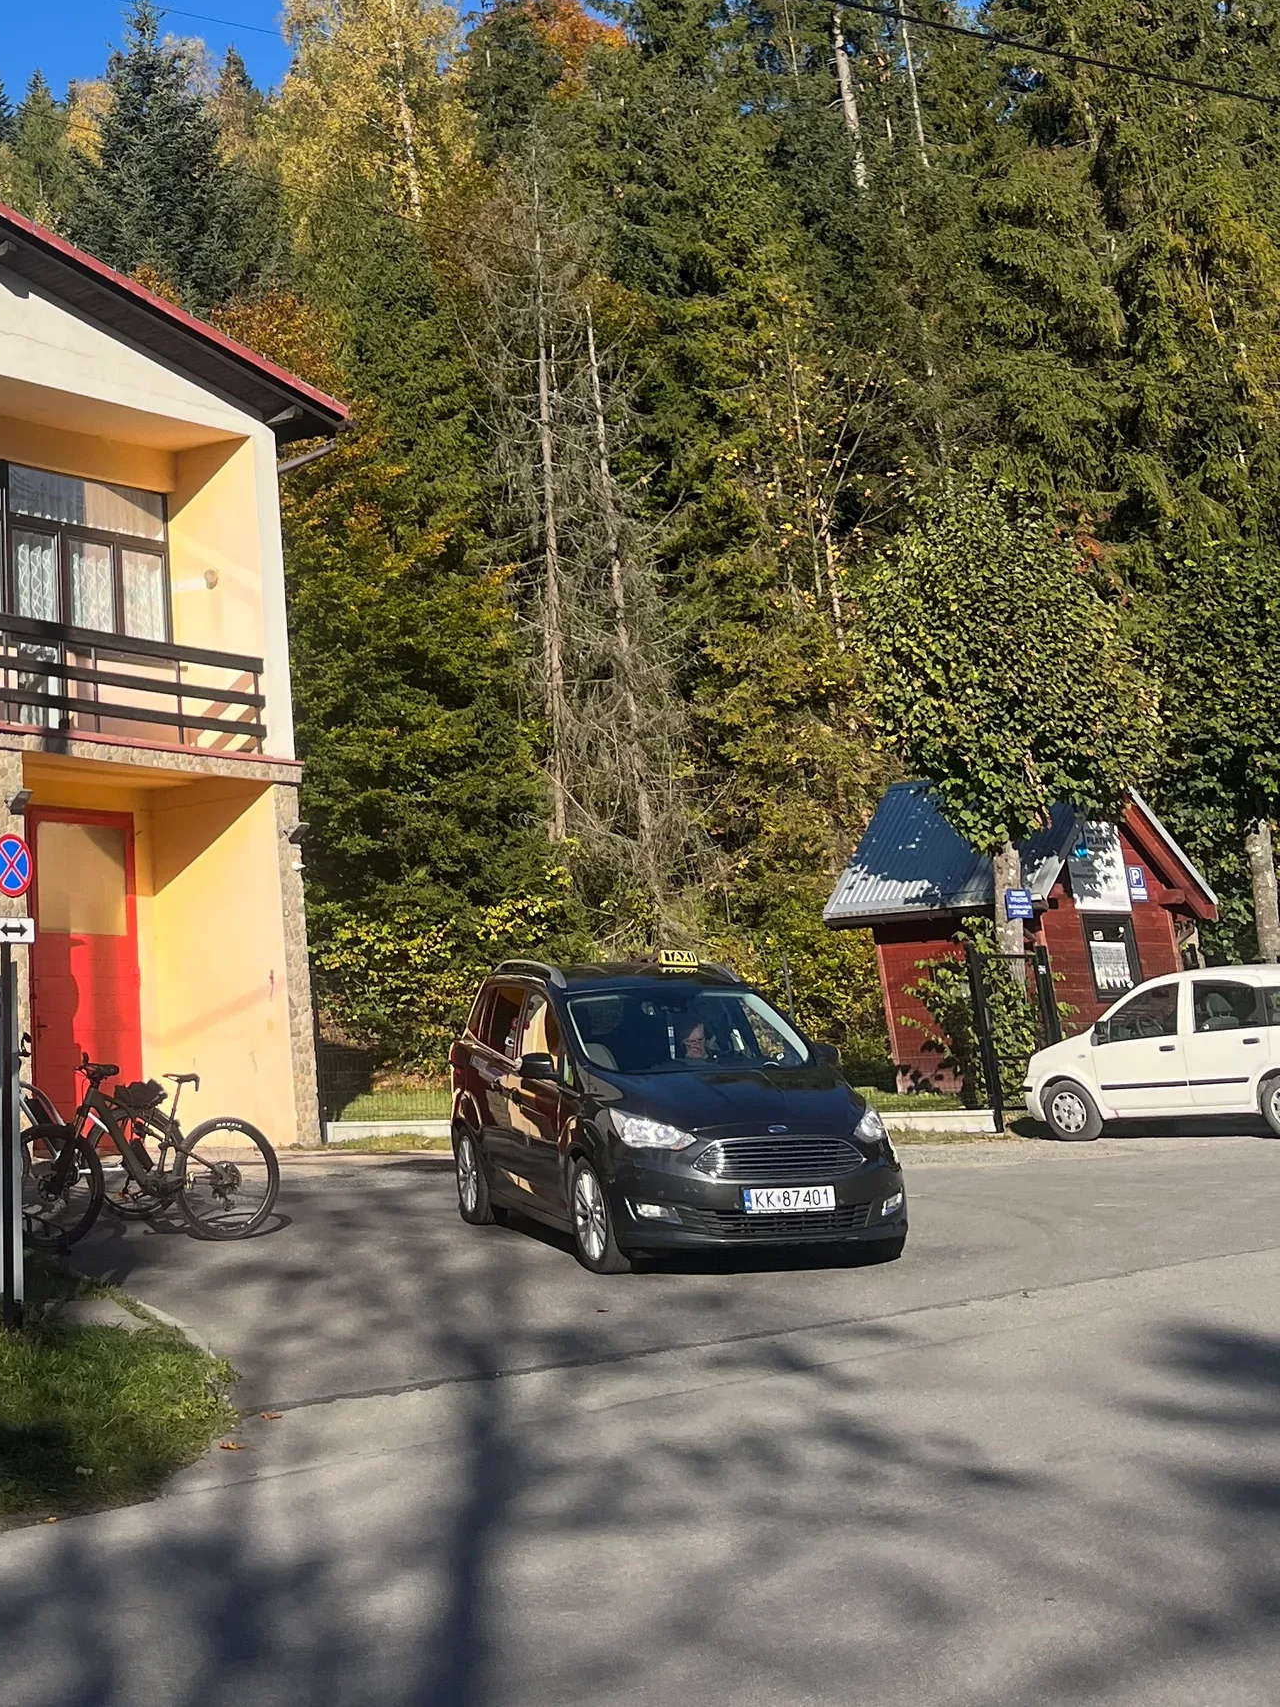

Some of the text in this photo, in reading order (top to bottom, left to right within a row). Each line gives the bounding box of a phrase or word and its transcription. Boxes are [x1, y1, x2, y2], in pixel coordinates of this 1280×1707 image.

[664, 950, 696, 963] TAXI
[754, 1190, 776, 1208] KK
[782, 1188, 829, 1207] 87401
